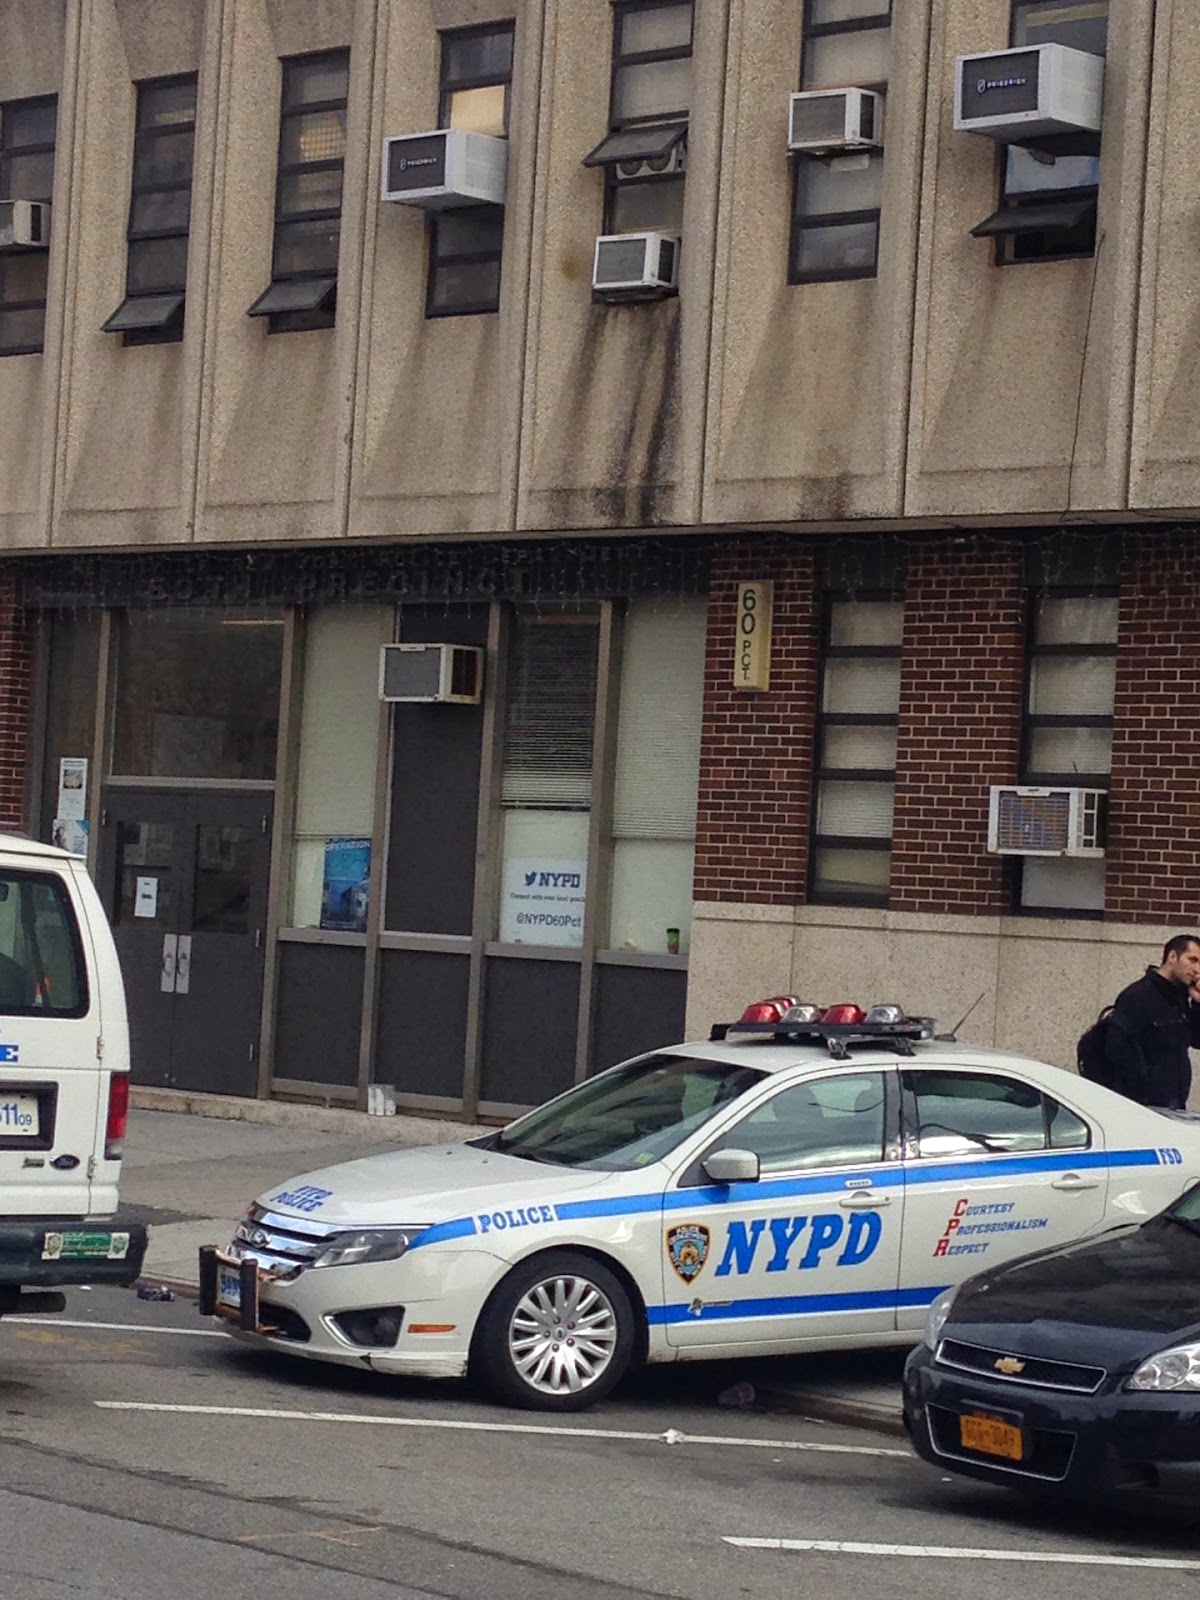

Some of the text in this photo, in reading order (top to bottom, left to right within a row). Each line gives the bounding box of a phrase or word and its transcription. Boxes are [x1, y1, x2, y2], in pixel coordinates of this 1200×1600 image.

[741, 589, 756, 635] 60
[539, 872, 581, 888] NYPD
[477, 1205, 554, 1234] POLICE
[714, 1211, 882, 1277] NYPD
